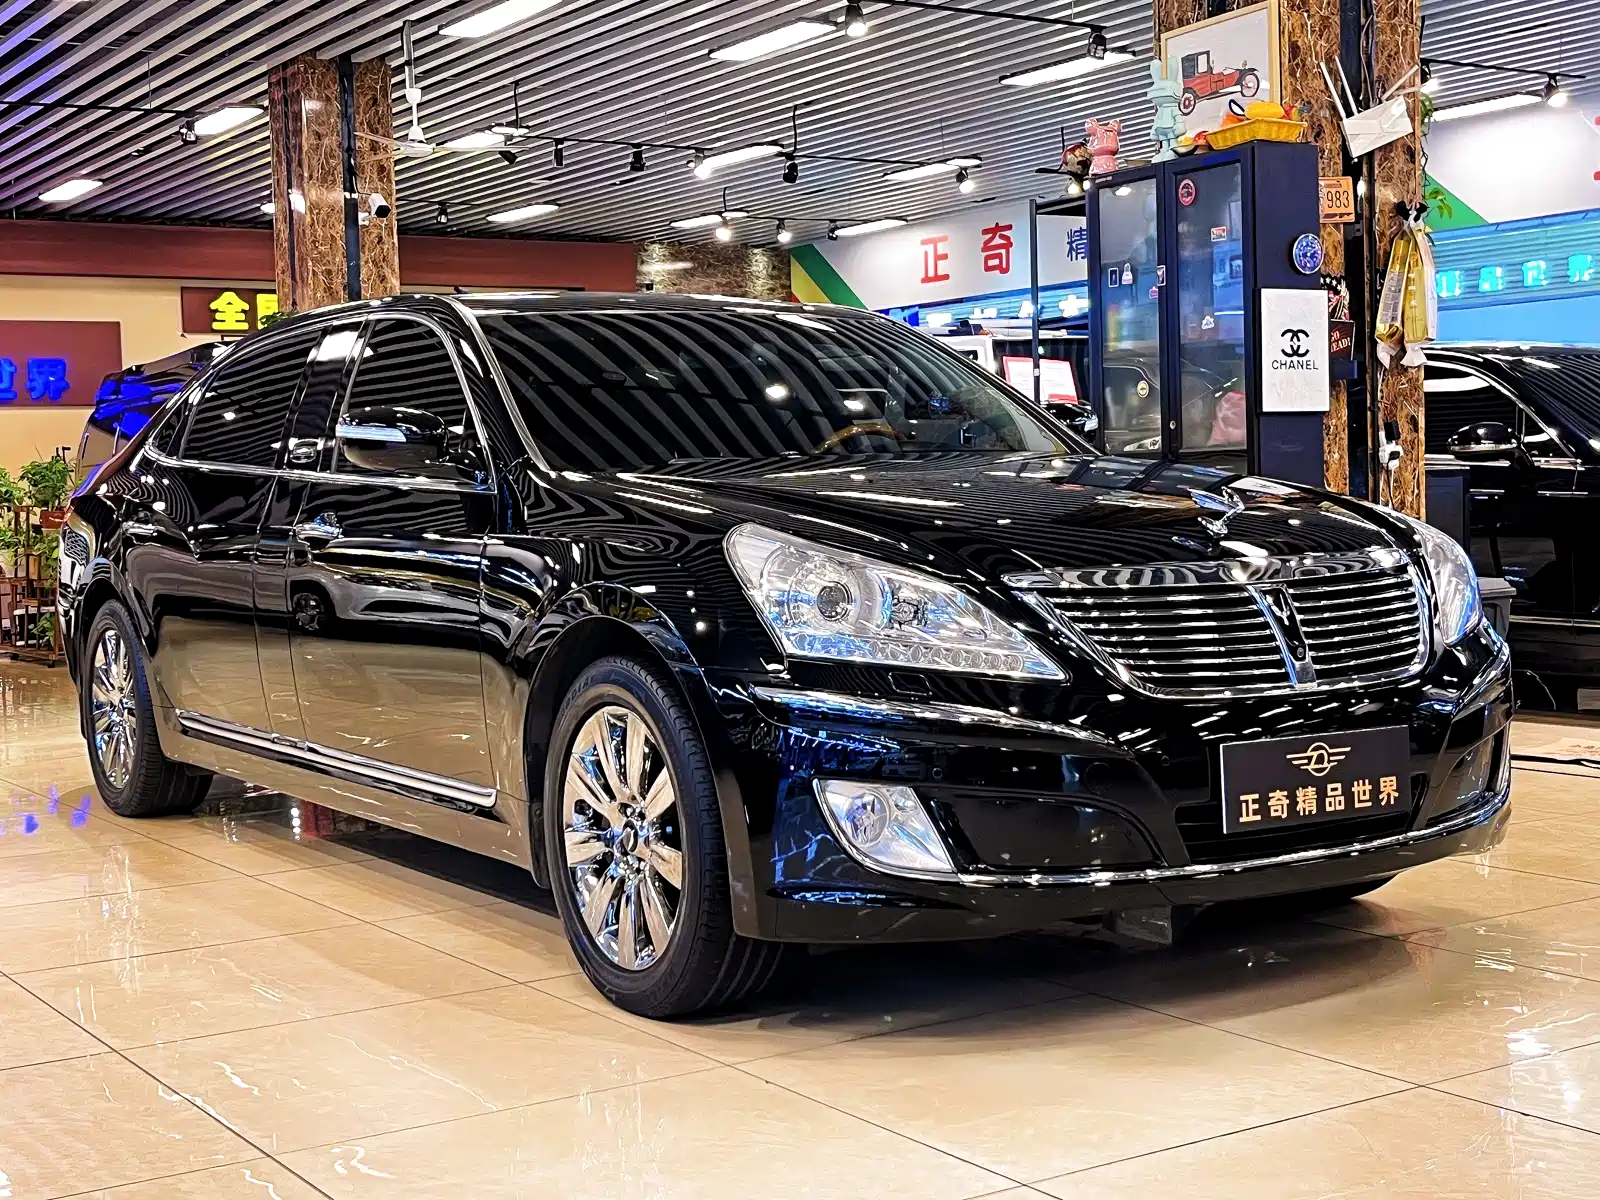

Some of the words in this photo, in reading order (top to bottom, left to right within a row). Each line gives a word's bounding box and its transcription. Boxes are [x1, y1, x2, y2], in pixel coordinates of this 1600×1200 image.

[1326, 190, 1350, 209] 983
[1271, 359, 1319, 371] CHANEL
[1239, 775, 1399, 823] 正奇精品世界
